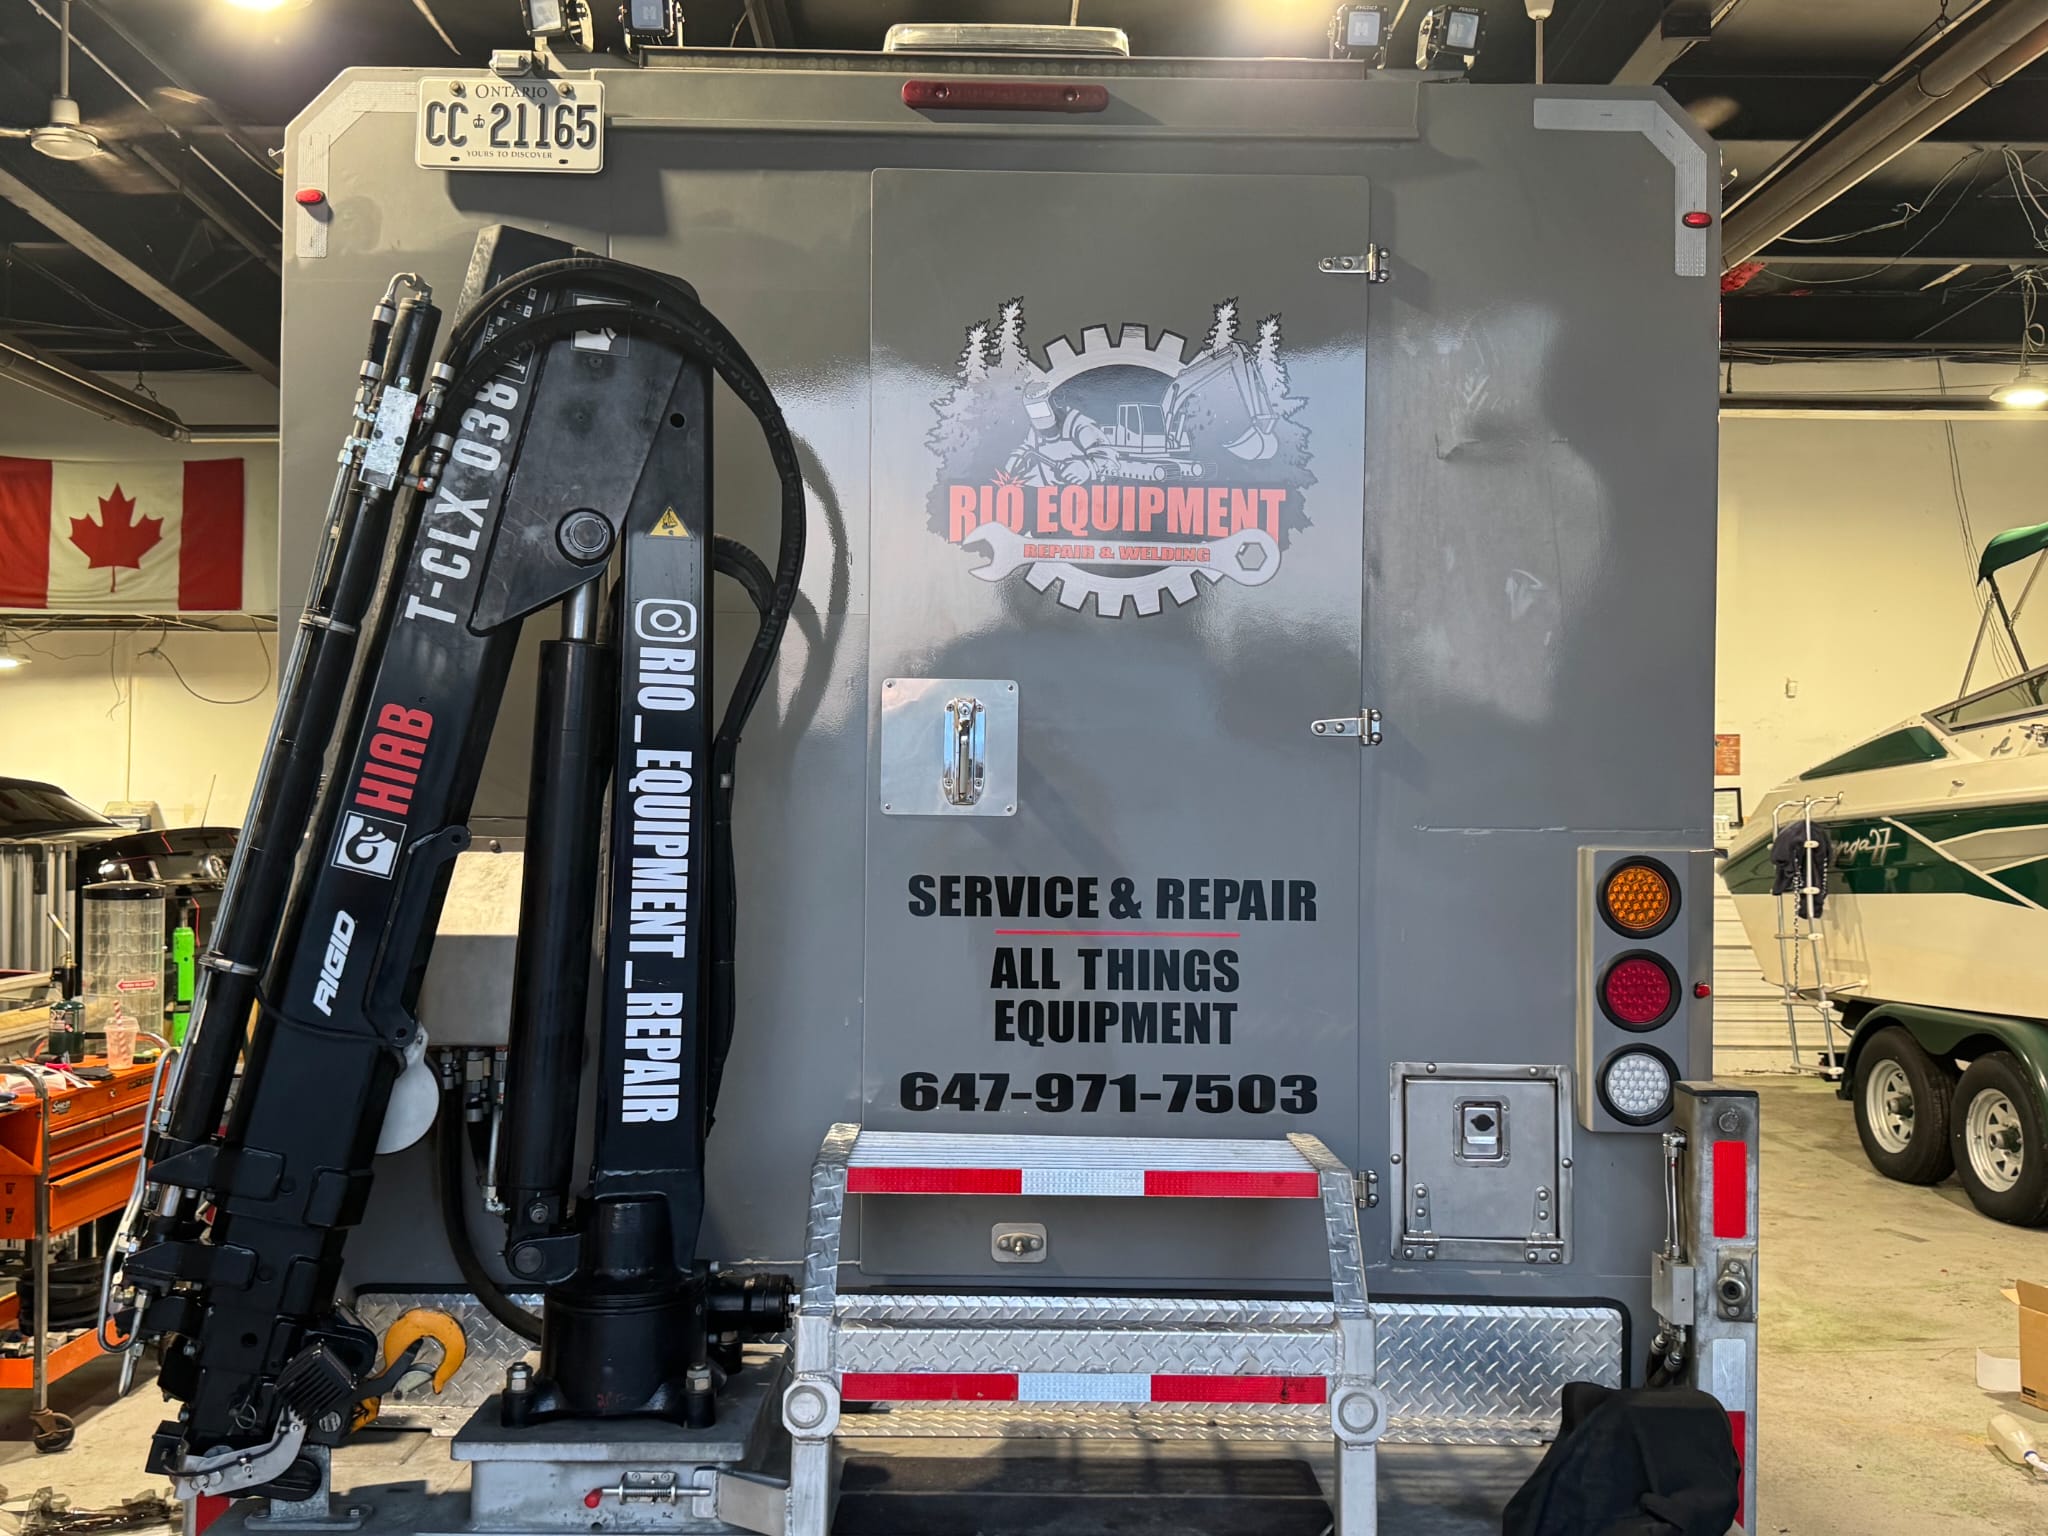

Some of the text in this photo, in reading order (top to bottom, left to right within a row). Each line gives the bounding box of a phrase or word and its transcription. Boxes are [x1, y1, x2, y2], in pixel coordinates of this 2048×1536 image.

[475, 84, 548, 99] ONTARIO
[426, 101, 598, 149] CC 21165
[466, 150, 494, 158] YOURS
[511, 151, 553, 160] DISCOVER
[405, 486, 490, 624] T-CLX
[452, 381, 519, 472] 038
[948, 484, 1286, 545] RIO EQUIPMENT
[1023, 543, 1211, 562] REPAIR & WELDING
[355, 703, 434, 816] HIAB
[908, 874, 1317, 922] SERVICE & REPAIR
[313, 910, 357, 1017] RIGID
[990, 946, 1240, 993] ALL THINGS
[994, 999, 1239, 1048] EQUIPMENT
[900, 1071, 1318, 1115] 647-971-7503
